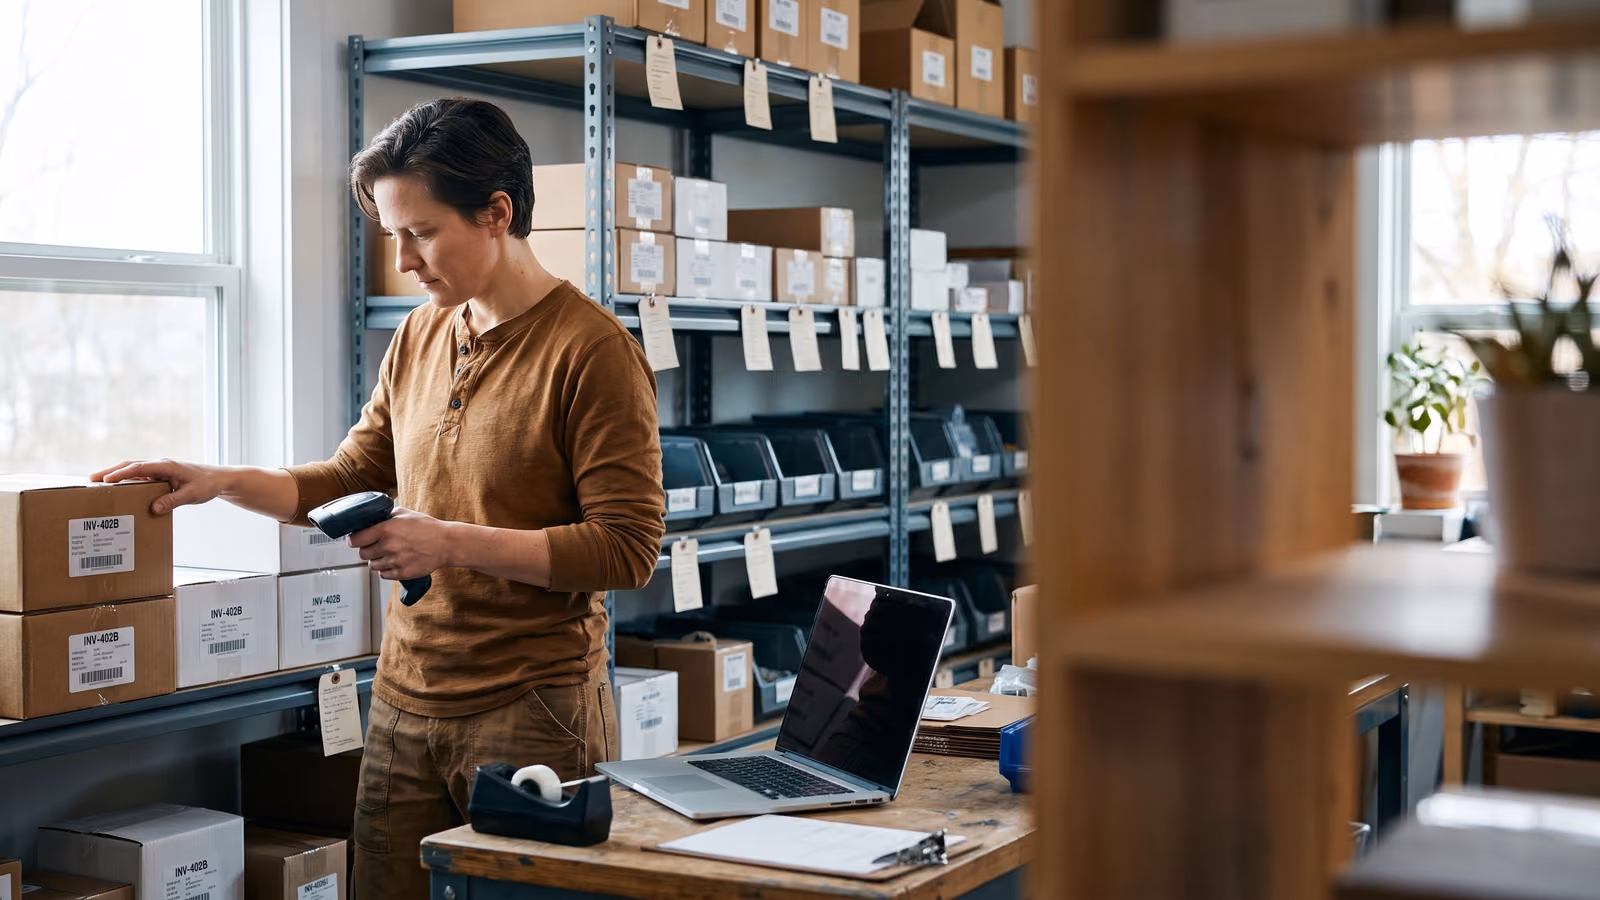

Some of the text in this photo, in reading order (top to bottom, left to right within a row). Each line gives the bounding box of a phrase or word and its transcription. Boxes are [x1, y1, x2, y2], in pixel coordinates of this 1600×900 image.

[83, 518, 120, 531] INV-402B
[311, 594, 341, 606] INV-402B
[210, 605, 243, 619] INV-402B
[83, 631, 120, 646] INV-402B
[175, 859, 208, 878] INV-402B
